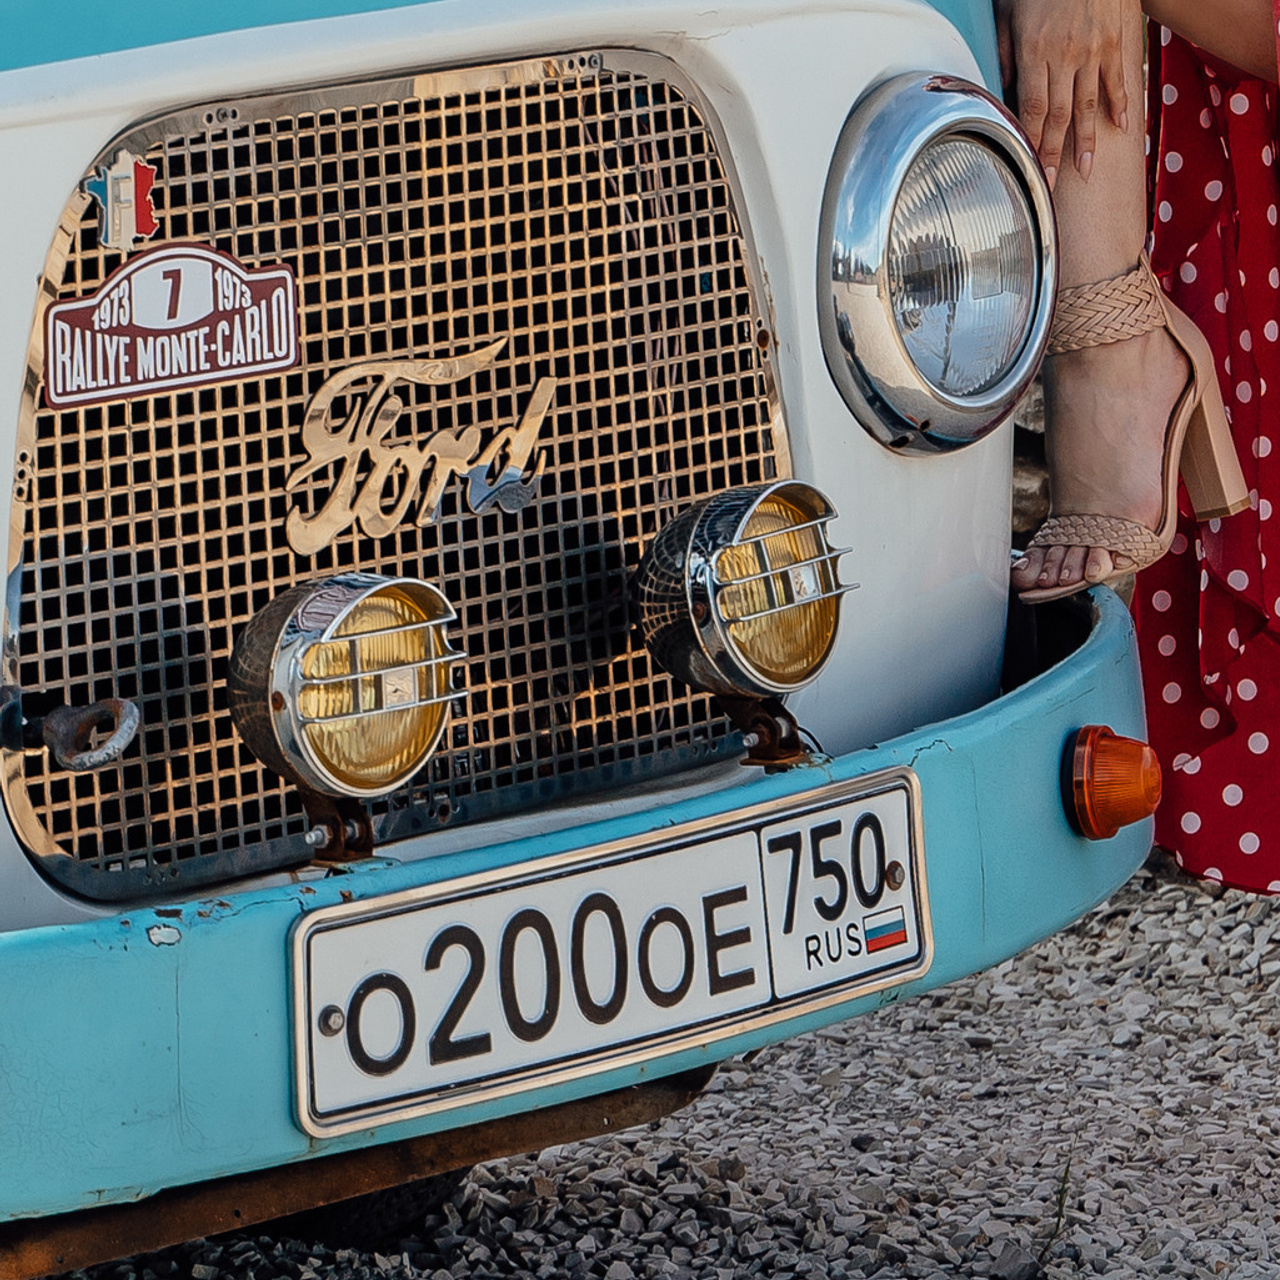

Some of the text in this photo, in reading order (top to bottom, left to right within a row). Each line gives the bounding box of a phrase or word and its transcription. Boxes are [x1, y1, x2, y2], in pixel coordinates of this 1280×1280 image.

[55, 287, 286, 393] RALLYE MONTE-CARLO
[91, 267, 252, 331] 1973 7 1973
[286, 336, 558, 556] Ford
[767, 811, 888, 935] 750
[804, 922, 863, 971] RUS
